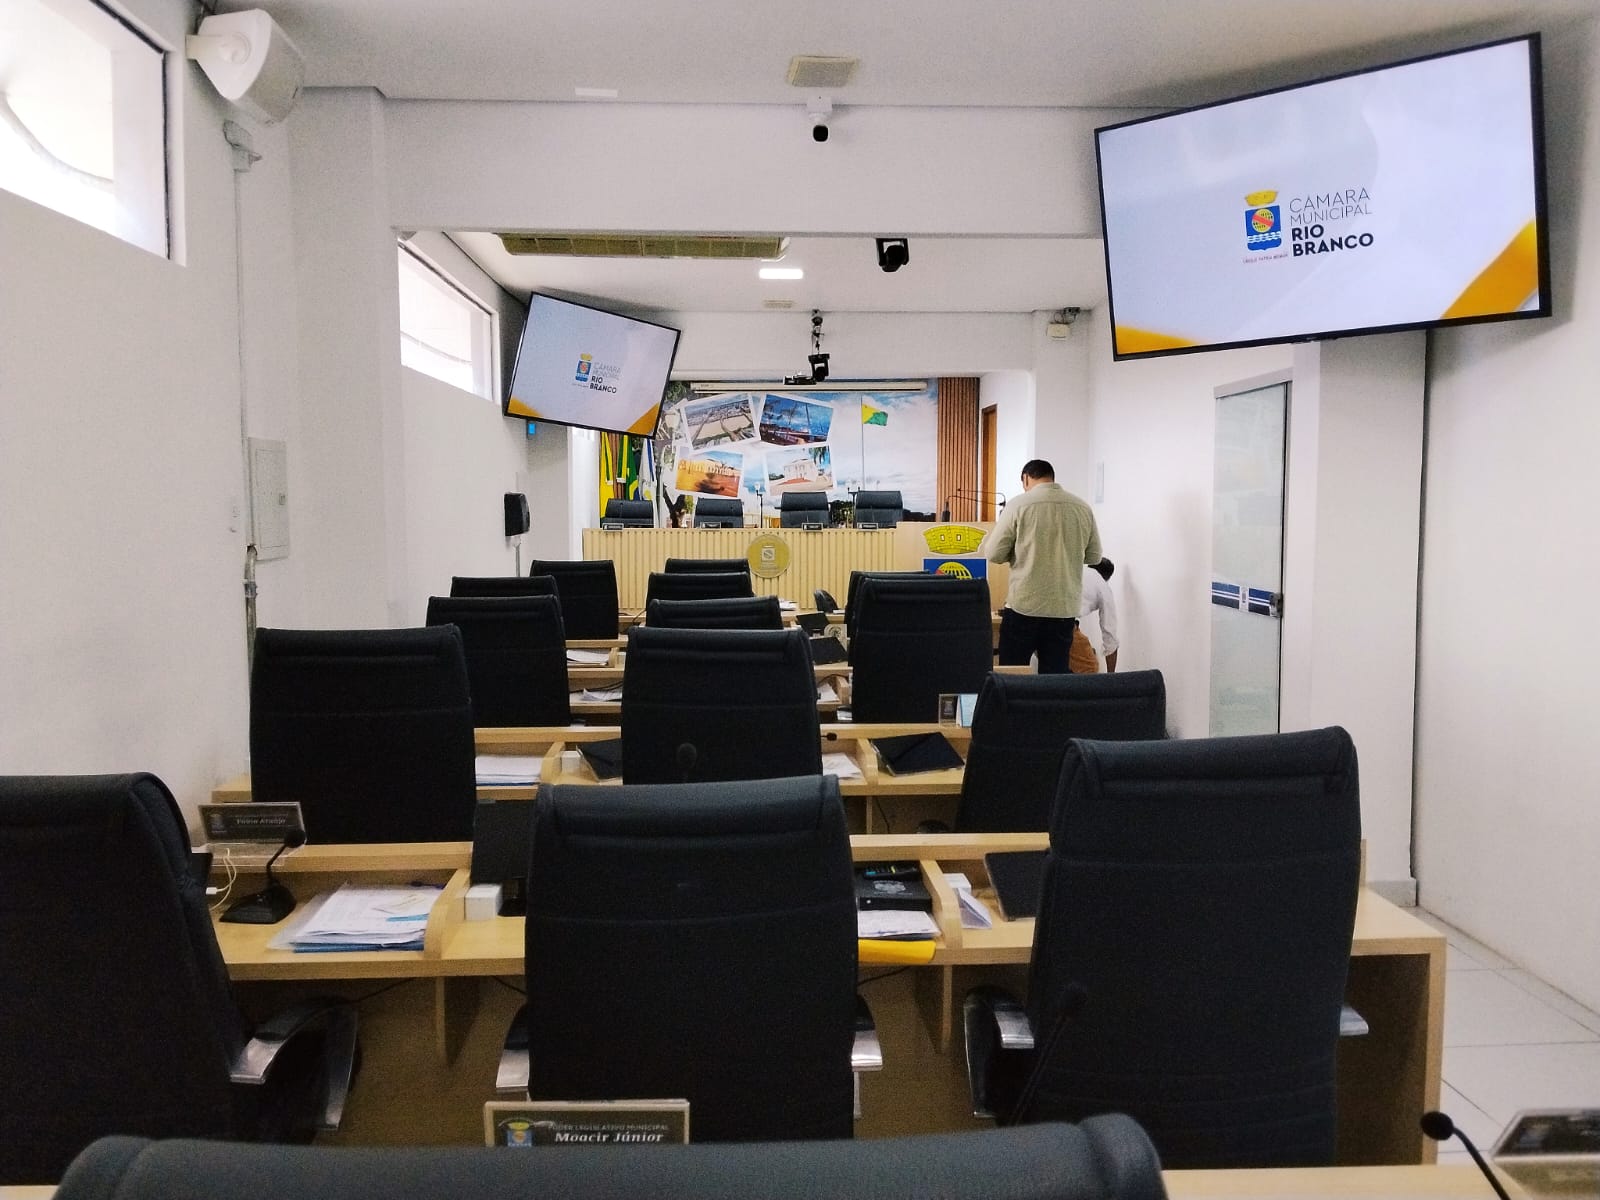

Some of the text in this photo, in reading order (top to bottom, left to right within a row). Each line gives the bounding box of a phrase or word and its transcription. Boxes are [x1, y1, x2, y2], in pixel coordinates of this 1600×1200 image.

[1290, 203, 1373, 227] MUNICIPAL
[1291, 224, 1325, 242] RIO
[1292, 233, 1374, 257] BRANCO
[591, 375, 604, 384] RIO
[589, 382, 617, 393] BRANCO
[554, 1130, 664, 1143] Moacir Júnior
